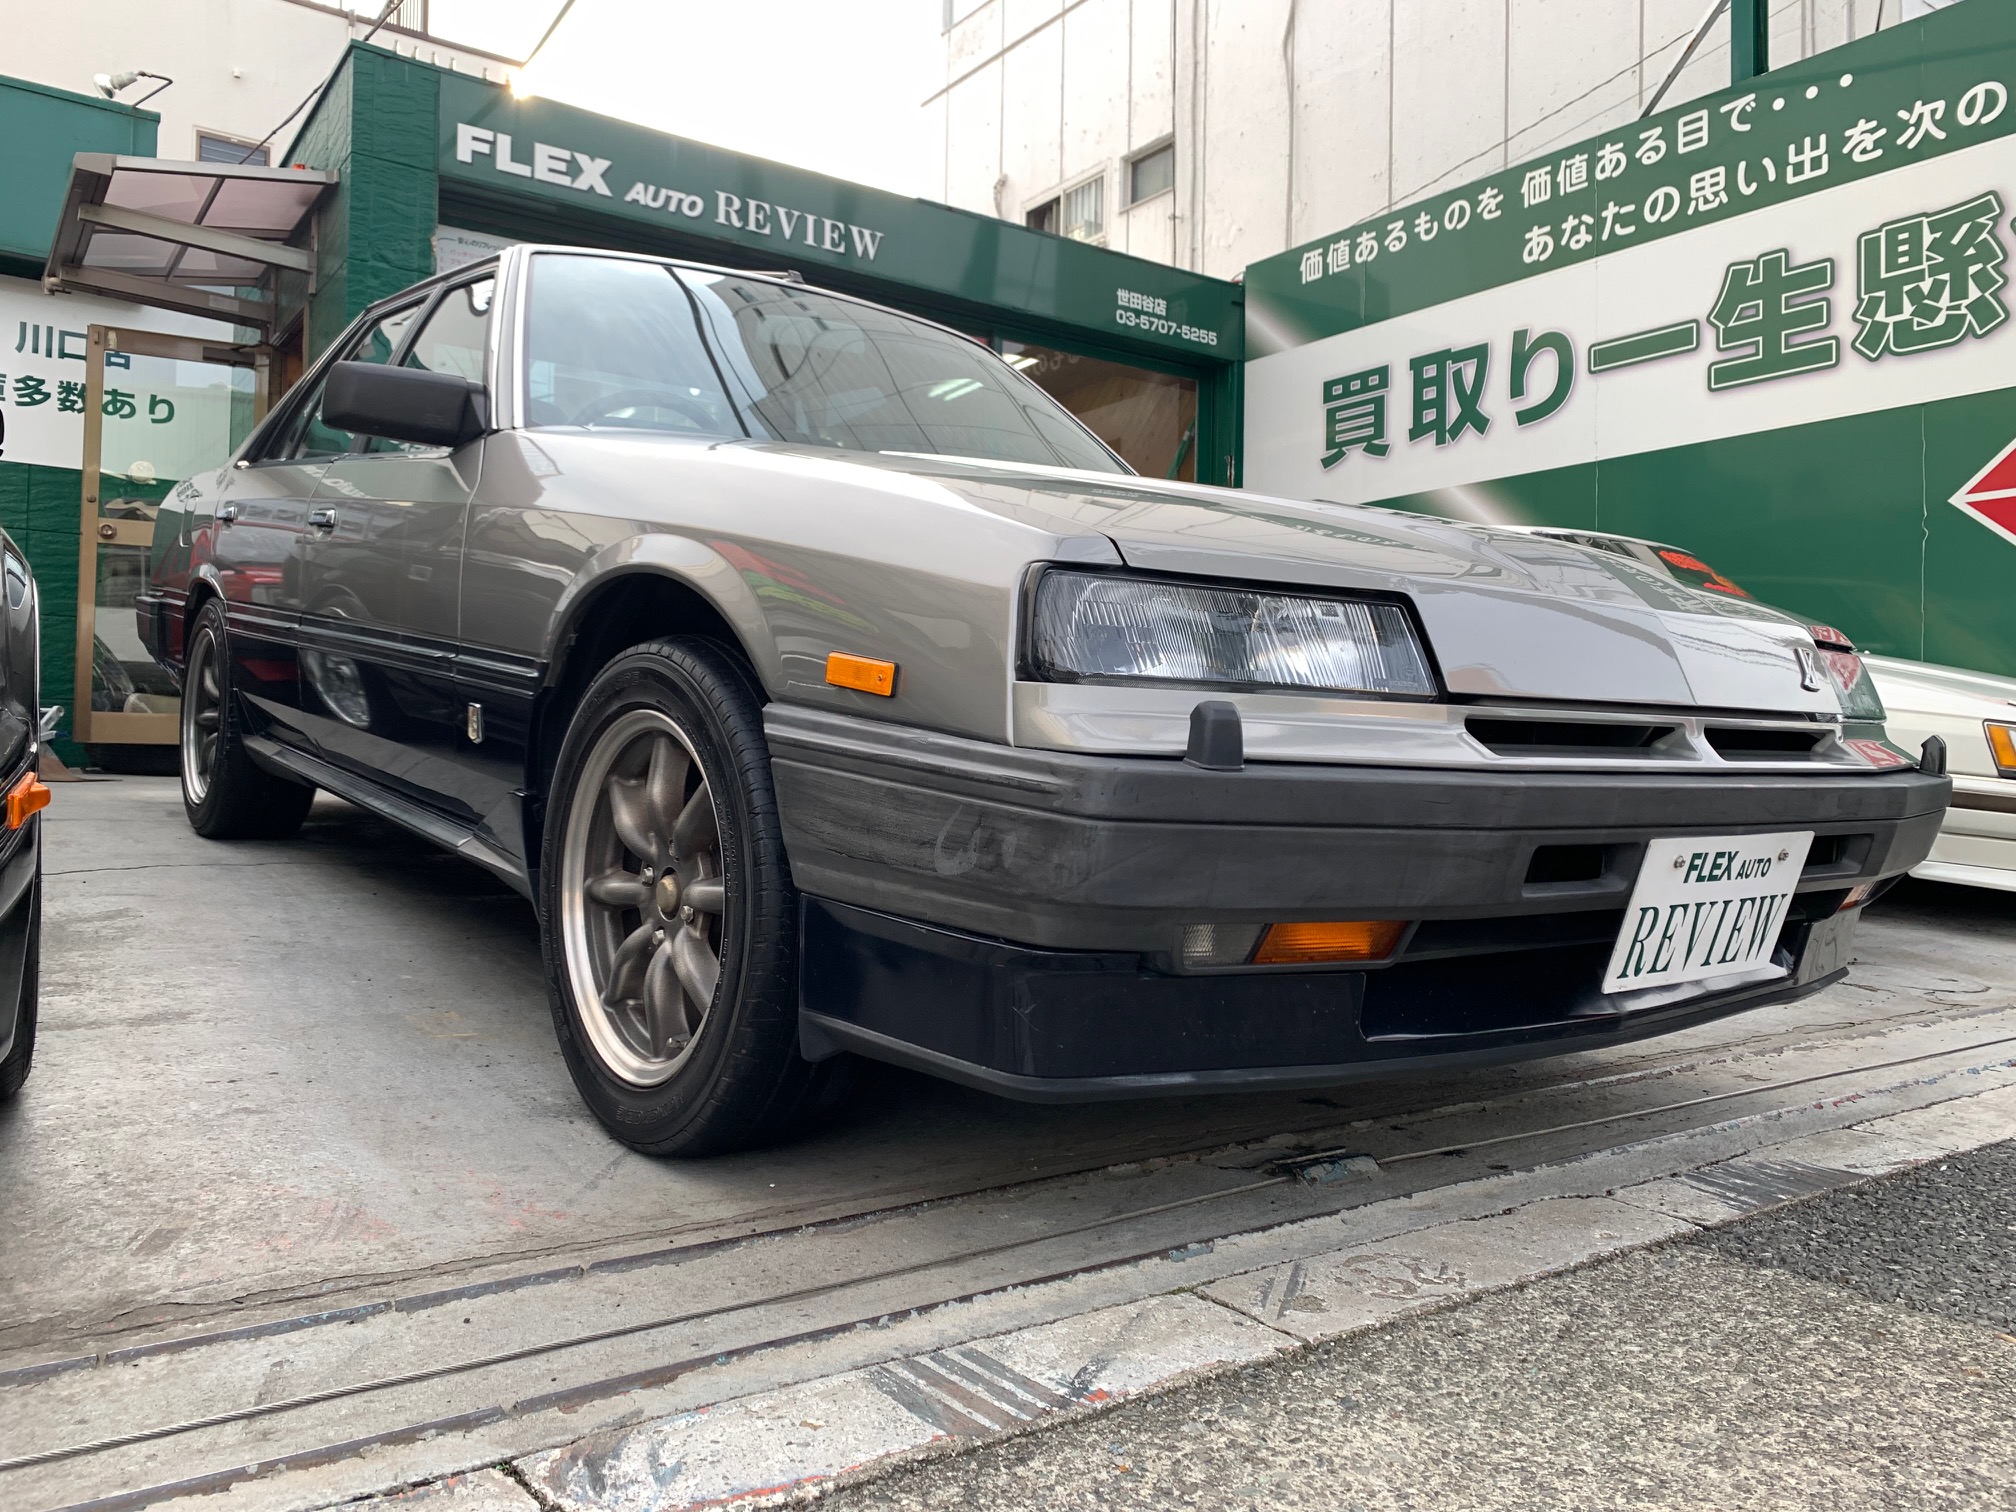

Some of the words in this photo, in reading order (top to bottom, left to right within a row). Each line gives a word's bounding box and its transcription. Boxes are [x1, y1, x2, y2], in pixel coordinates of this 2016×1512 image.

[456, 122, 613, 197] FLEX
[624, 182, 703, 218] AUTO
[714, 189, 885, 261] REVIEW
[1522, 80, 2008, 264] あなたの思い出を次の
[1299, 188, 1504, 285] 価値あるものを
[1116, 288, 1167, 316] 世田谷店
[1116, 309, 1217, 346] 03-5707-5255
[1320, 189, 2016, 469] 買取り一生懸
[1683, 851, 1739, 884] FLEX
[1735, 857, 1772, 880] AUTO
[1616, 893, 1789, 979] REVIEW
